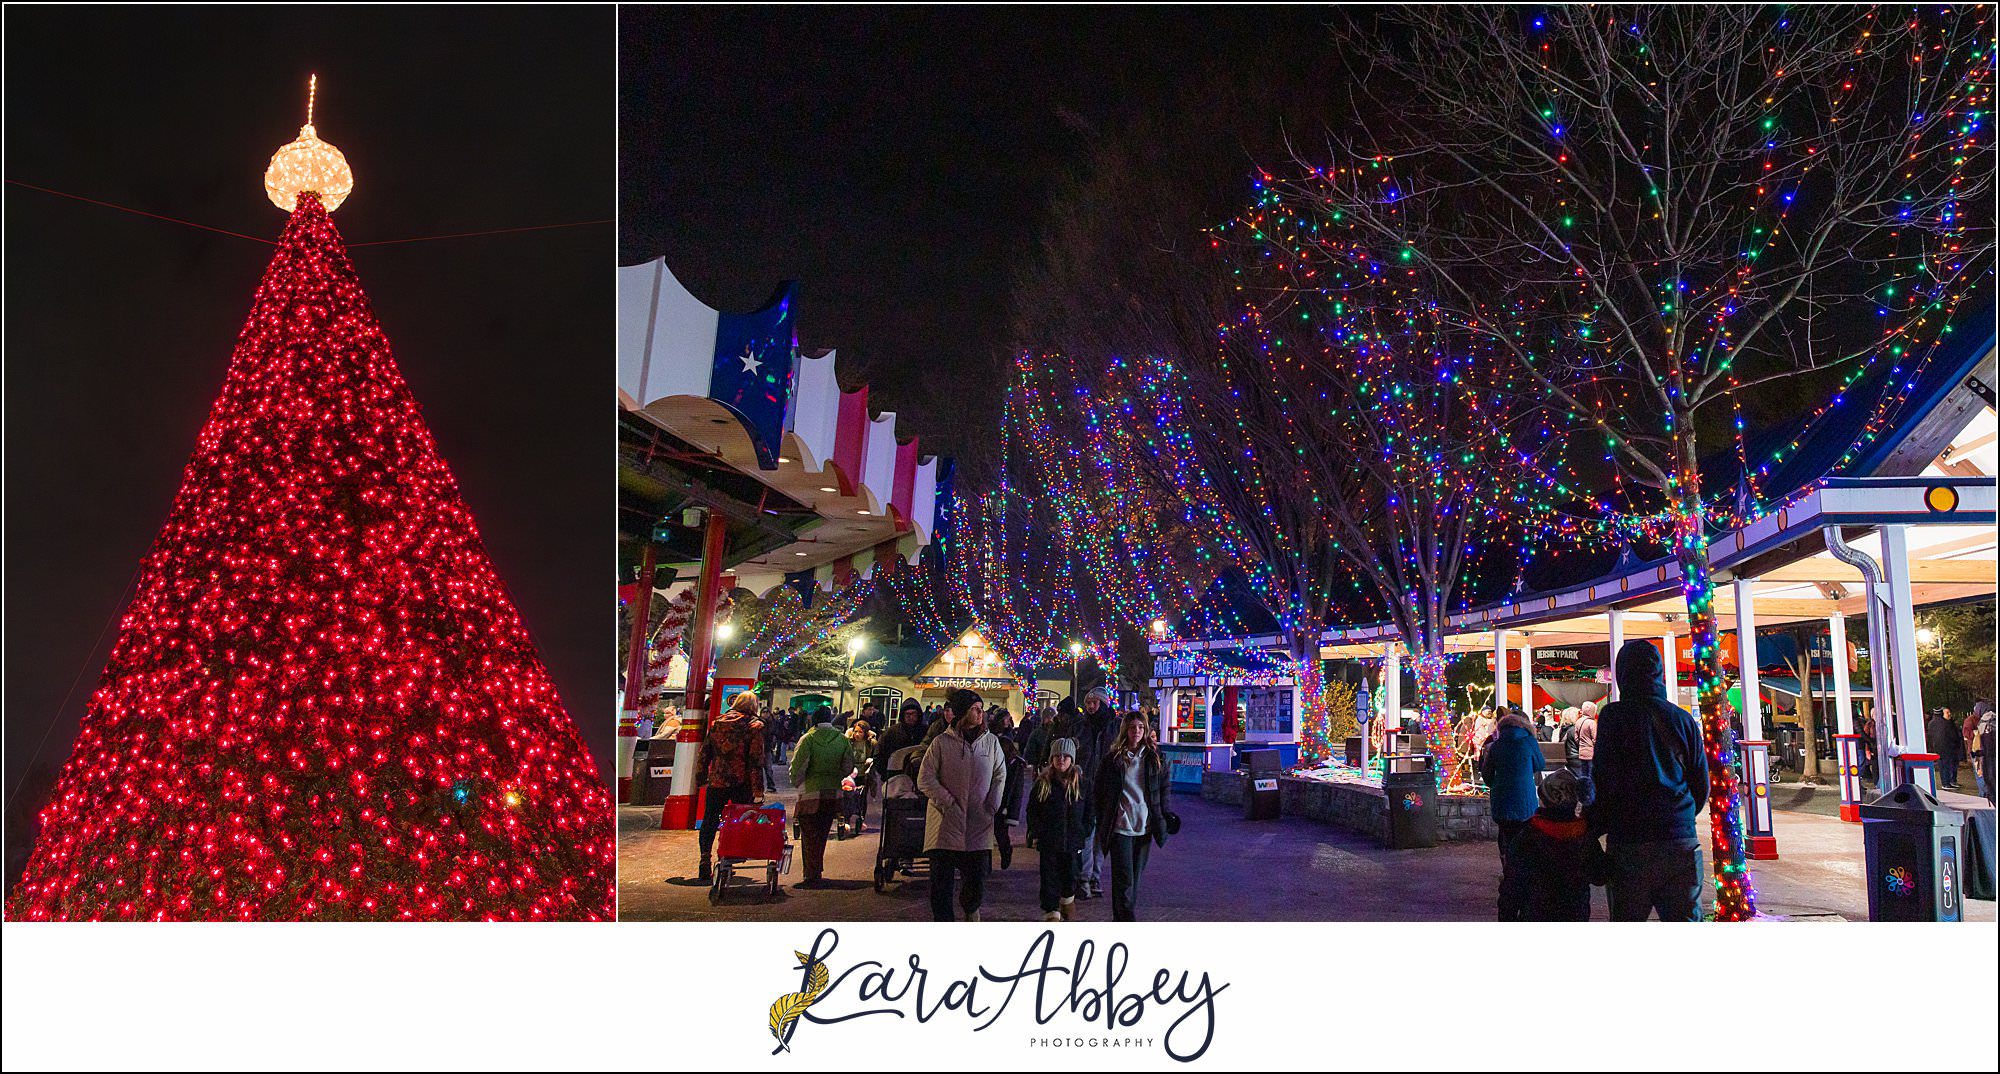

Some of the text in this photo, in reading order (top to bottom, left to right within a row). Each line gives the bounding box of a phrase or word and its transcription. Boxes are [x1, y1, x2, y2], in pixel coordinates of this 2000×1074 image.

[1536, 650, 1579, 660] HERSHEYPARK
[1154, 660, 1172, 677] FACE
[933, 677, 1002, 691] Surfside Styles
